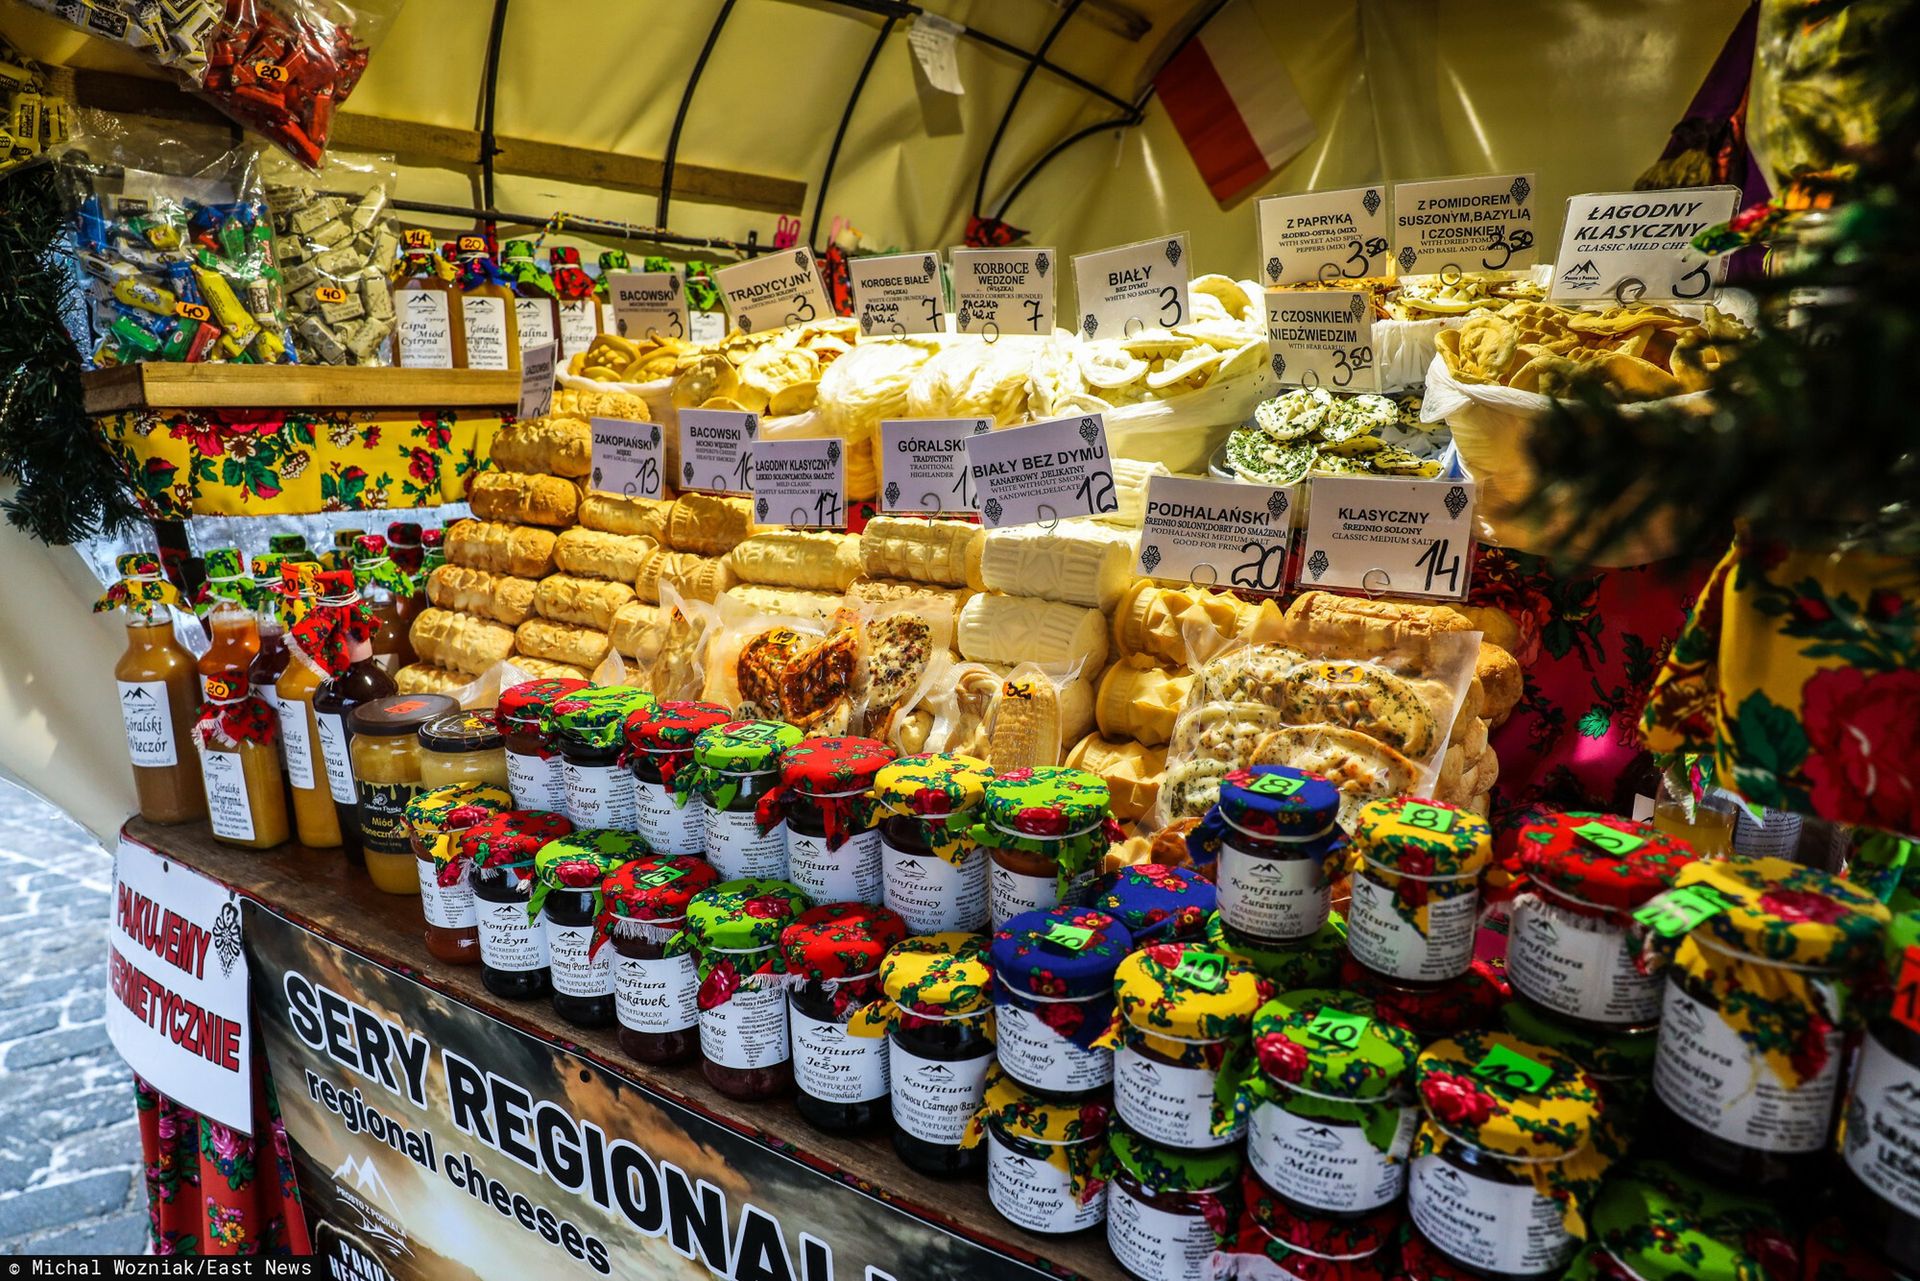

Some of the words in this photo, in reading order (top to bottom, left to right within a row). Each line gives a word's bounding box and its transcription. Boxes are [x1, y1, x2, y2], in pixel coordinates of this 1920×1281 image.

[261, 65, 281, 79] 20
[1417, 200, 1426, 210] Z
[1429, 194, 1511, 209] POMIDOREM
[1587, 202, 1702, 221] ŁAGODNY
[1286, 219, 1295, 229] Z
[1297, 213, 1353, 228] PAPRYKĄ
[410, 232, 425, 244] 14
[1428, 225, 1505, 239] CZOSNKIEM
[1574, 222, 1708, 241] KLASYCZNY
[465, 239, 482, 250] 20
[1577, 242, 1625, 253] CLASSIC
[1626, 242, 1660, 251] MILD
[973, 262, 1029, 274] KORBOCE
[1109, 265, 1152, 286] BIAŁY
[728, 272, 812, 303] TRADYCYJNY
[861, 277, 903, 288] KOROBCE
[904, 275, 930, 285] BIAŁE
[978, 275, 1024, 286] WĘDZONE
[1115, 285, 1128, 294] BEZ
[1128, 282, 1148, 291] DYMU
[320, 289, 342, 301] 40
[620, 291, 674, 302] BACOWSKI
[1104, 293, 1126, 303] WHITE
[1127, 291, 1137, 299] NO
[183, 305, 205, 318] 40
[793, 295, 816, 322] 3
[922, 297, 942, 332] 7
[1159, 285, 1182, 328] 3
[1024, 300, 1043, 331] 7
[1271, 310, 1279, 323] Z
[1281, 310, 1353, 324] CZOSNKIEM
[668, 312, 683, 339] 3
[1270, 326, 1357, 343] NIEDŹWIEDZIM
[595, 434, 651, 450] ZAKOPIAŃSKI
[690, 427, 741, 440] BACOWSKI
[898, 437, 966, 452] GÓRALSKI
[756, 460, 788, 471] ŁAGODNY
[790, 460, 830, 471] KLASYCZNY
[912, 455, 953, 463] TRADYCYJNY
[974, 460, 1018, 478] BIAŁY
[1022, 454, 1054, 471] BEZ
[1058, 447, 1104, 465] DYMU
[635, 457, 660, 494] 13
[989, 472, 1039, 487] KANAPKOWY
[991, 484, 1016, 494] WHITE
[1018, 479, 1051, 490] WITHOUT
[1076, 471, 1118, 514] 12
[814, 492, 841, 526] 17
[1148, 502, 1270, 525] PODHALAŃSKI
[1338, 508, 1430, 524] KLASYCZNY
[1145, 517, 1176, 527] ŚREDNIO
[1234, 526, 1246, 534] DO
[1247, 527, 1286, 538] SMAŻENIA
[1342, 523, 1383, 532] ŚREDNIO
[1384, 526, 1422, 535] SOLONY
[1173, 539, 1198, 547] GOOD
[1212, 534, 1248, 543] MEDIUM
[1332, 532, 1366, 541] CLASSIC
[1368, 535, 1410, 544] MEDIUM
[1412, 537, 1435, 546] SALT
[1231, 542, 1286, 589] 20
[1415, 539, 1460, 592] 14
[207, 683, 225, 696] 20
[371, 817, 394, 828] Miód
[648, 870, 674, 884] 15
[792, 871, 825, 887] Wiśni
[885, 871, 944, 893] Konfitura
[1231, 877, 1304, 896] Konfitura
[889, 889, 940, 908] Brusznicy
[1240, 894, 1292, 913] Żurawiny
[117, 880, 212, 981] PAKUJEMY
[490, 936, 529, 947] Jeżyn
[1178, 959, 1221, 982] 10
[283, 969, 431, 1110] SERY
[1312, 1021, 1357, 1042] 10
[798, 1035, 866, 1056] Konfitura
[805, 1056, 851, 1073] Jeżyn
[903, 1075, 973, 1094] Konfitura
[1119, 1066, 1185, 1104] Konfitura
[1474, 1064, 1535, 1090] 10
[900, 1090, 921, 1106] Owocu
[922, 1100, 959, 1115] Czarnego
[960, 1101, 976, 1111] Bzu
[1272, 1133, 1358, 1166] Konfitura
[305, 1067, 438, 1175] regional
[443, 1150, 612, 1276] cheeses
[1284, 1156, 1343, 1180] Malin
[992, 1161, 1057, 1194] Konfitura
[336, 1185, 366, 1209] PROSTO
[365, 1206, 372, 1215] Z
[1028, 1196, 1064, 1209] Jagody
